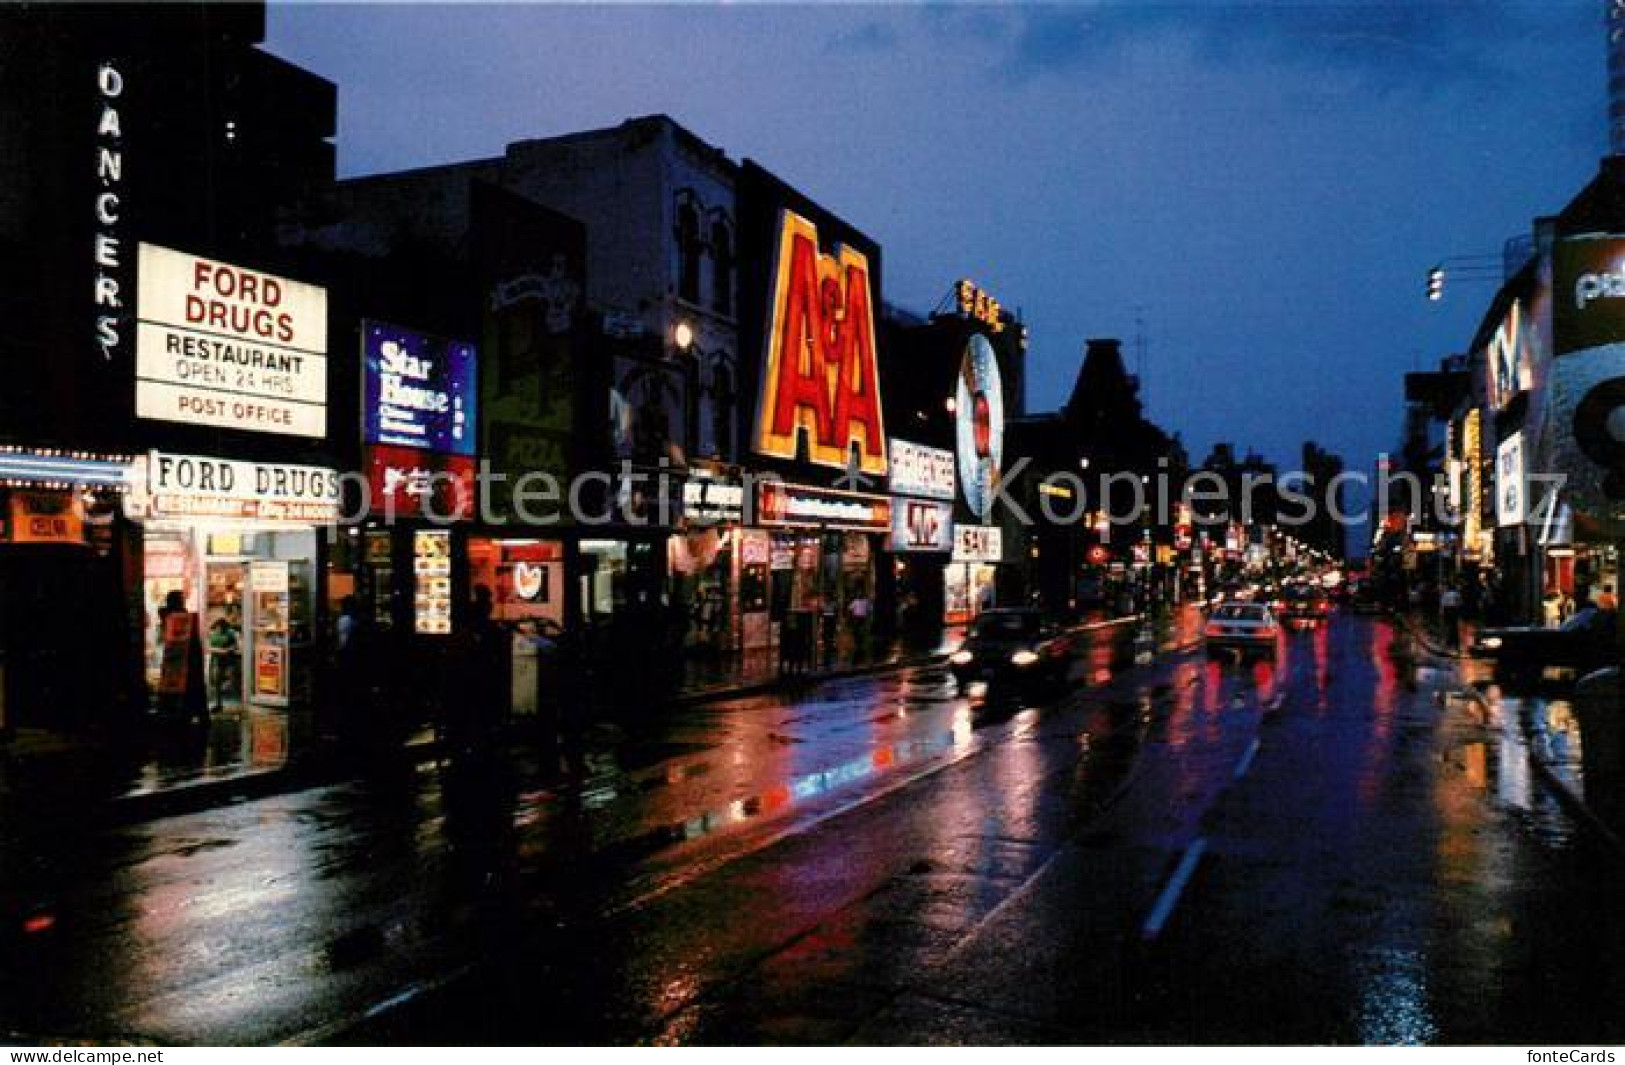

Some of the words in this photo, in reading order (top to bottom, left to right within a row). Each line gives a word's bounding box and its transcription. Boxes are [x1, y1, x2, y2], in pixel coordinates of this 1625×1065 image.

[96, 65, 123, 350] DANCERS
[194, 261, 281, 307] FORD
[185, 295, 294, 341] DRUGS
[167, 334, 303, 373] RESTAURANT
[380, 341, 432, 380] Star
[176, 359, 226, 382] OPEN
[262, 374, 293, 394] HRS
[178, 396, 226, 416] POST
[233, 403, 293, 425] OFFICE
[158, 456, 235, 492] FORD
[255, 465, 340, 498] DRUGS
